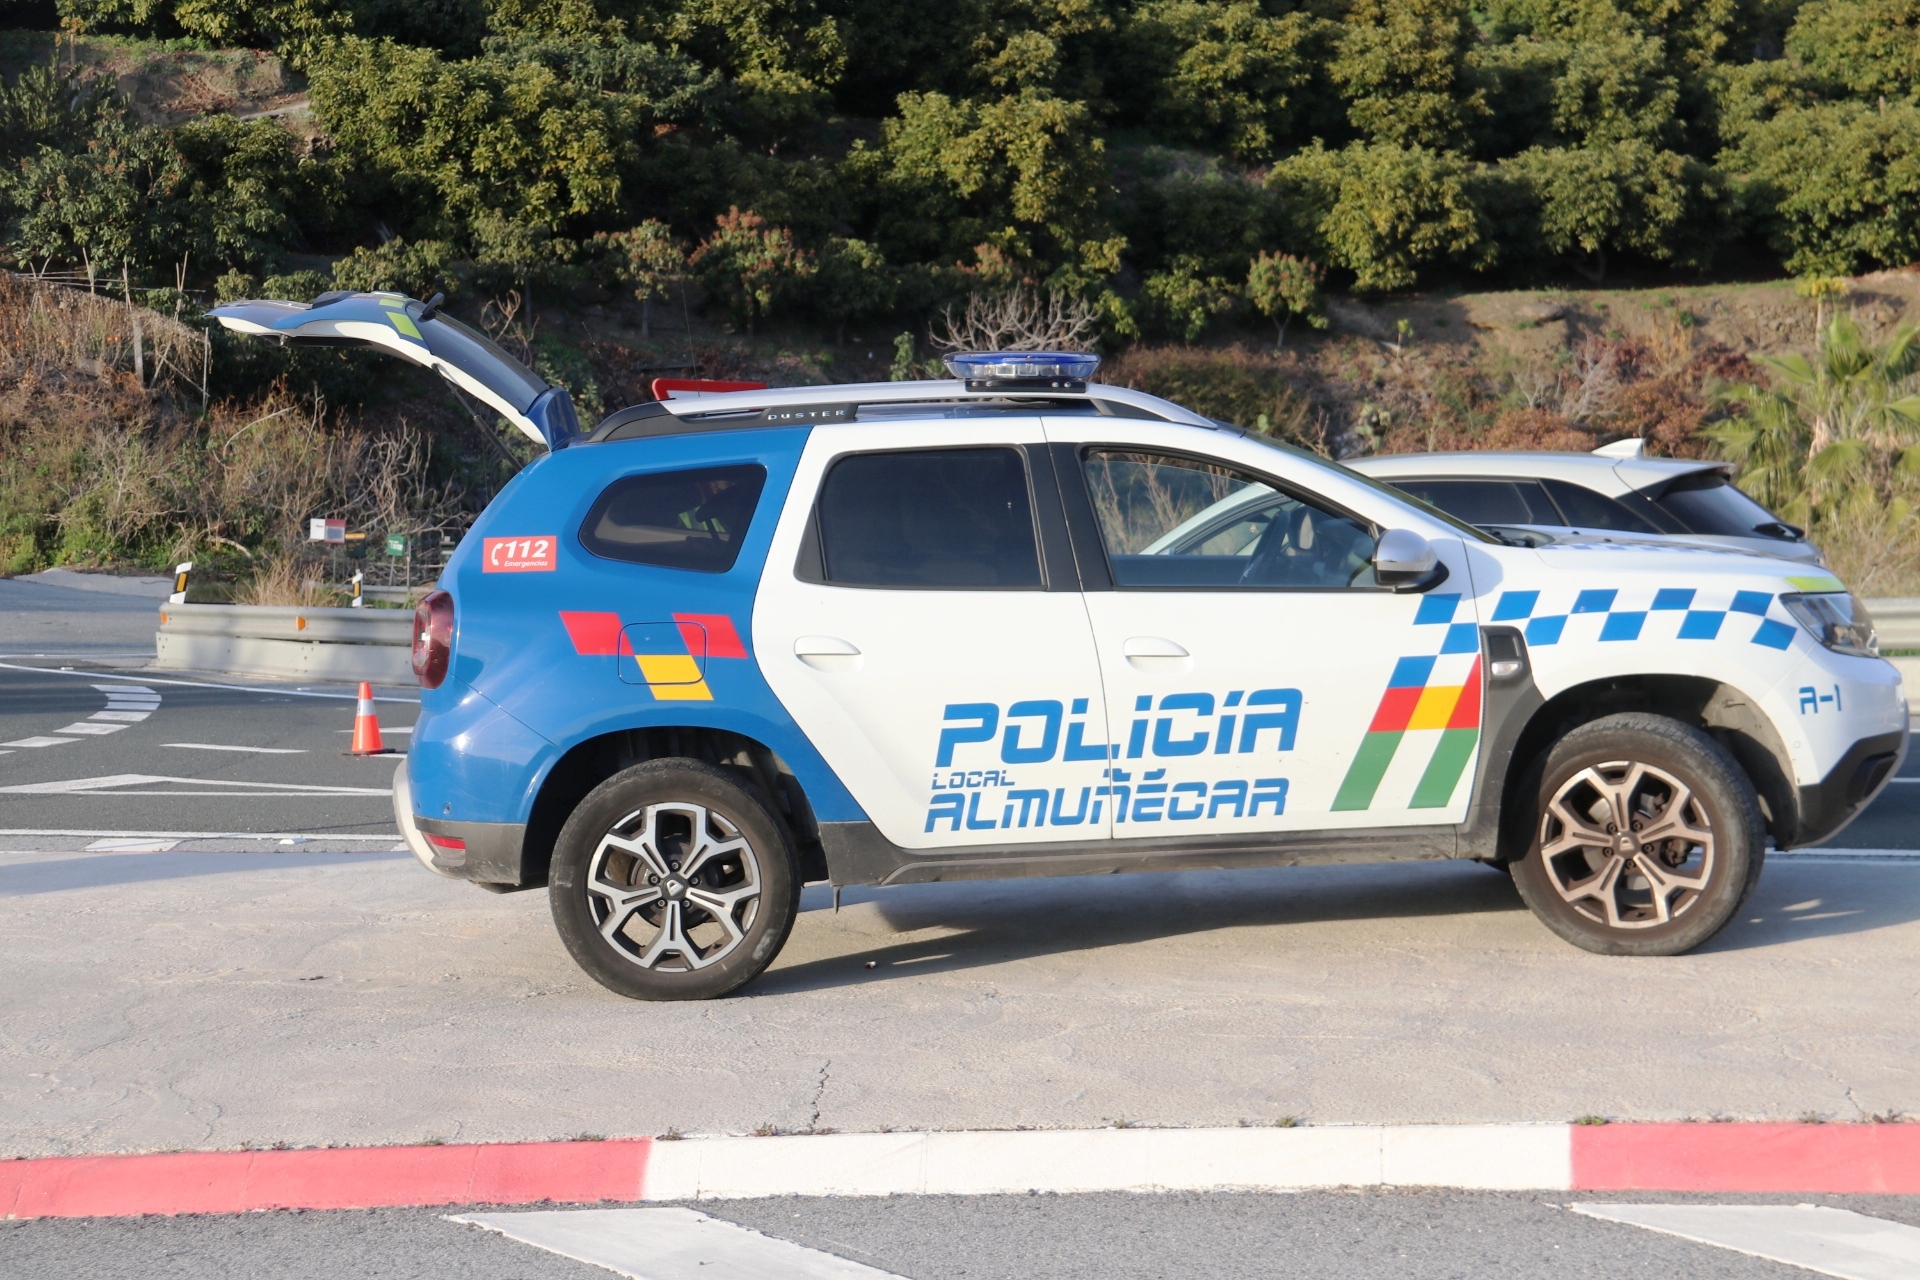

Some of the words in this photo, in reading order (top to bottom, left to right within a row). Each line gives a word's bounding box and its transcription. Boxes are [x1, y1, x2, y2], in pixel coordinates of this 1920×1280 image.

[768, 410, 845, 420] DUSTER
[505, 540, 549, 558] 112
[504, 560, 548, 568] Emergencias
[1799, 684, 1841, 714] A-1
[935, 688, 1303, 767] POLICÍA
[931, 770, 1015, 790] LOCAL
[924, 768, 1290, 833] ALMUÑÉCAR
